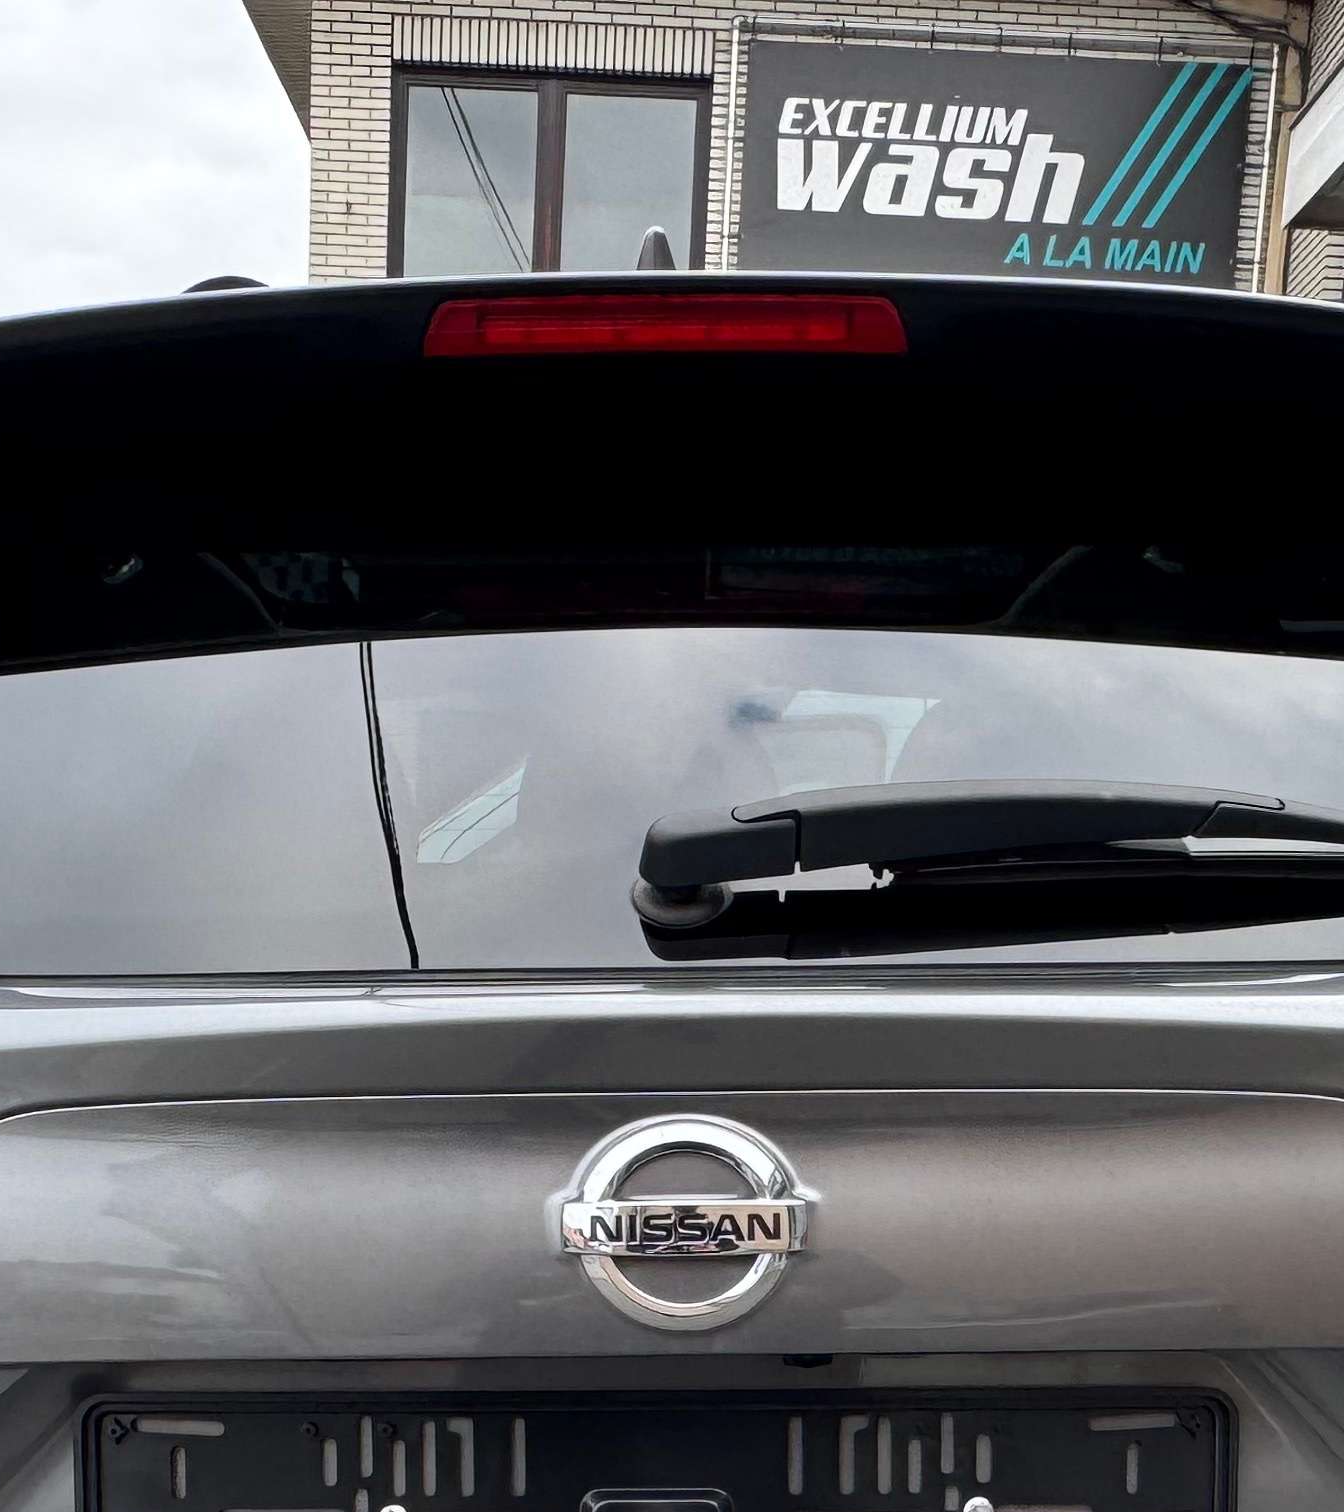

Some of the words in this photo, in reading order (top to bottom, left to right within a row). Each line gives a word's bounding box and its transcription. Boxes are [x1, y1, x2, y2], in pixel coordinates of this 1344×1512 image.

[778, 97, 1029, 146] EXCELLIUM
[777, 133, 1086, 225] wash
[1003, 232, 1031, 265] A
[1042, 234, 1092, 269] LA
[1104, 238, 1205, 274] MAIN
[589, 1212, 781, 1243] NISSAN
